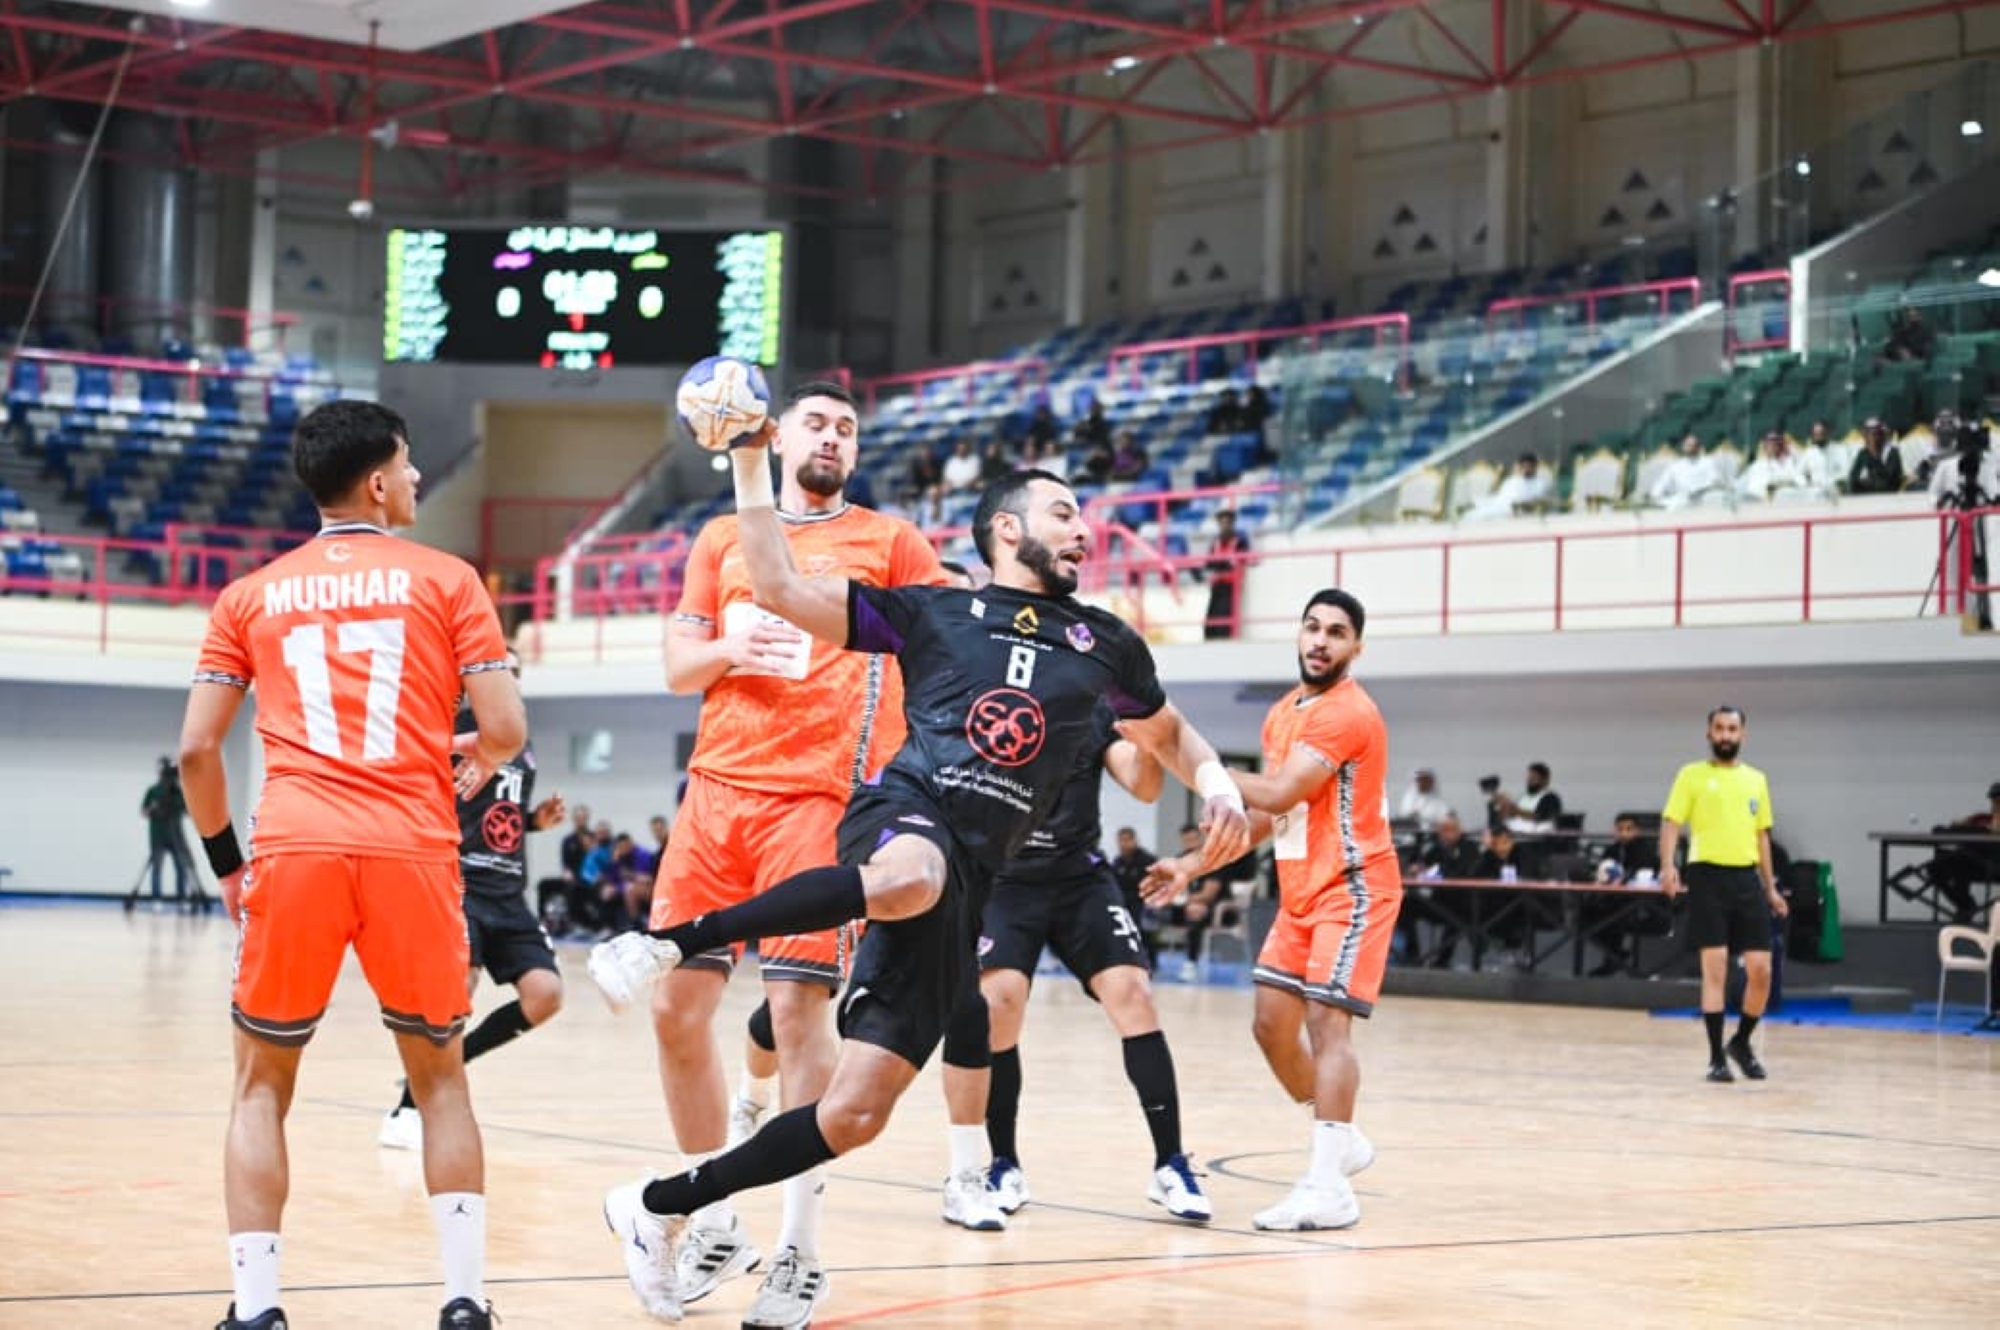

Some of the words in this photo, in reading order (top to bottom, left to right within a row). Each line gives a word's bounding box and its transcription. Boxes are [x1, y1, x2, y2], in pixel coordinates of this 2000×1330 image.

[264, 569, 411, 616] MUDHAR
[1005, 645, 1036, 689] 8
[282, 618, 405, 762] 17
[495, 768, 523, 804] 20
